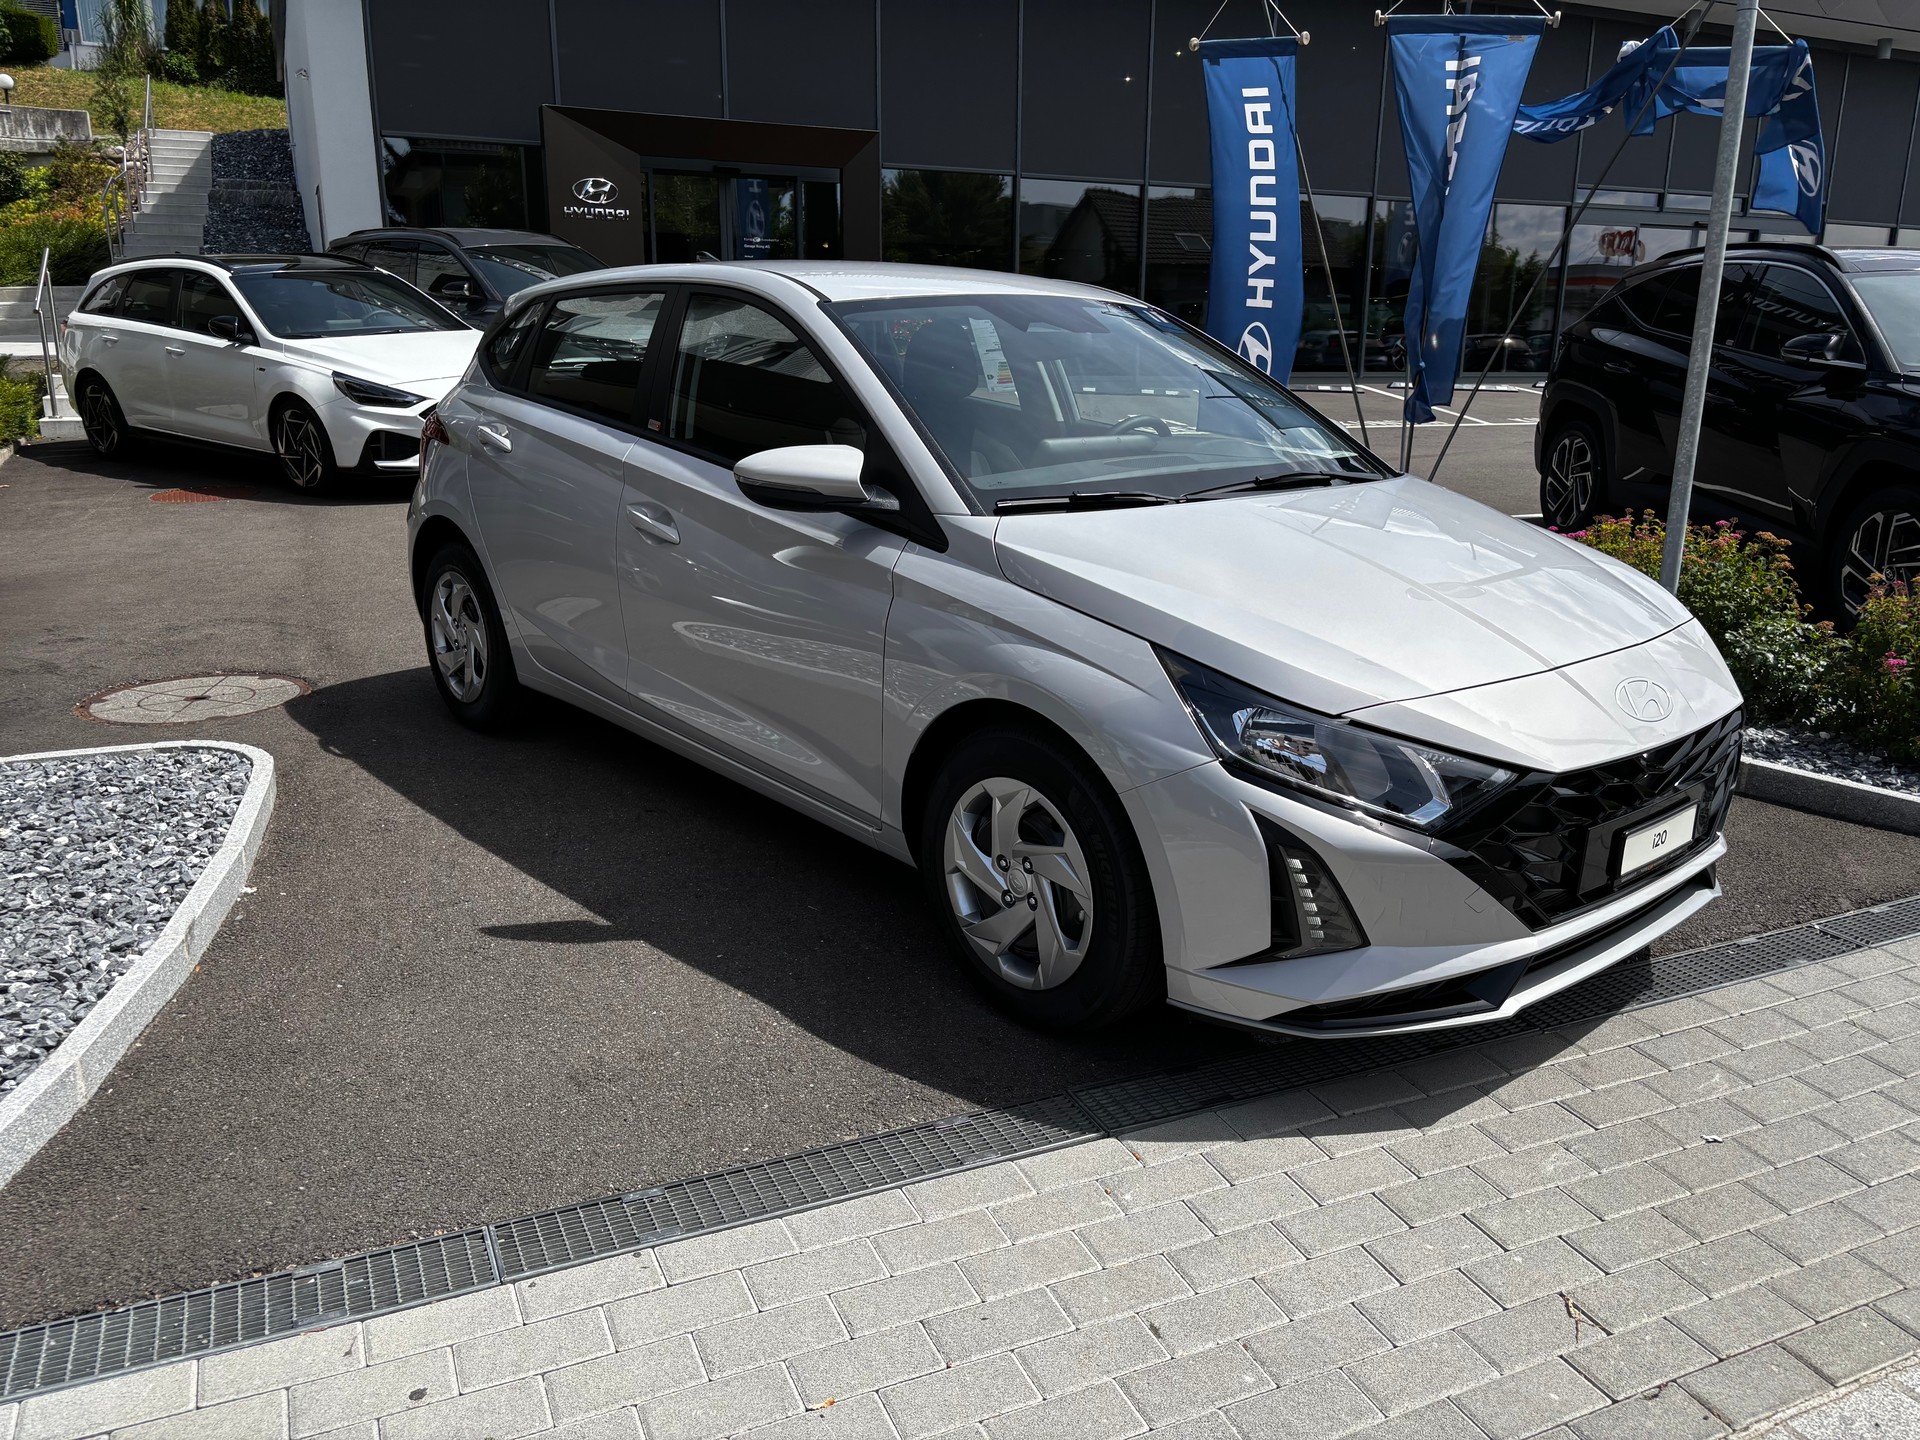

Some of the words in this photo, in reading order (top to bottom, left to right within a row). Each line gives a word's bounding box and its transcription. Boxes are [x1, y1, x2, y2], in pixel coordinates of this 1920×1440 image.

[1241, 87, 1278, 309] HYUNDAI
[563, 206, 630, 221] HYUNDAI
[1651, 829, 1669, 849] i20
